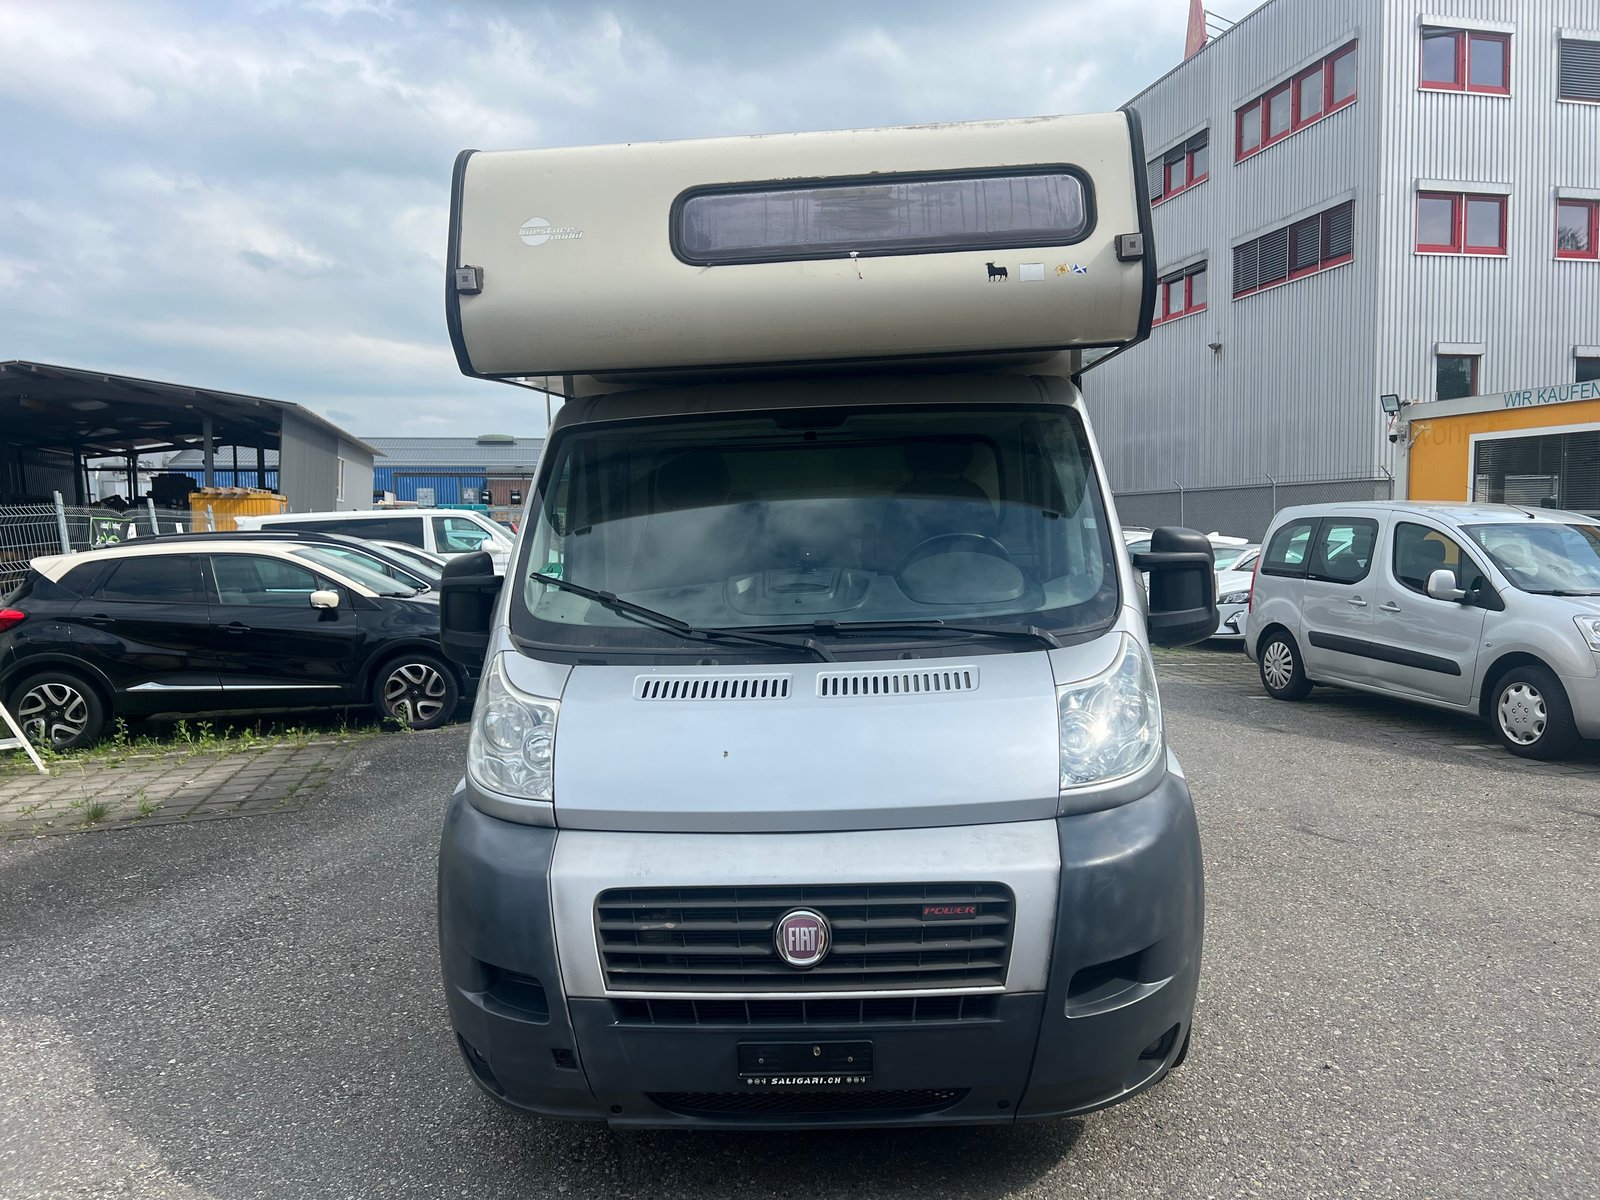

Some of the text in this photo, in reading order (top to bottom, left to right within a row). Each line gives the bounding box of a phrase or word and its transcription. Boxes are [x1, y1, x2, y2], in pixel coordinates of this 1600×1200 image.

[1504, 391, 1532, 407] WIR
[923, 906, 975, 915] POWER
[788, 927, 817, 951] FIAT
[771, 1077, 841, 1085] SALIGARI.CH
